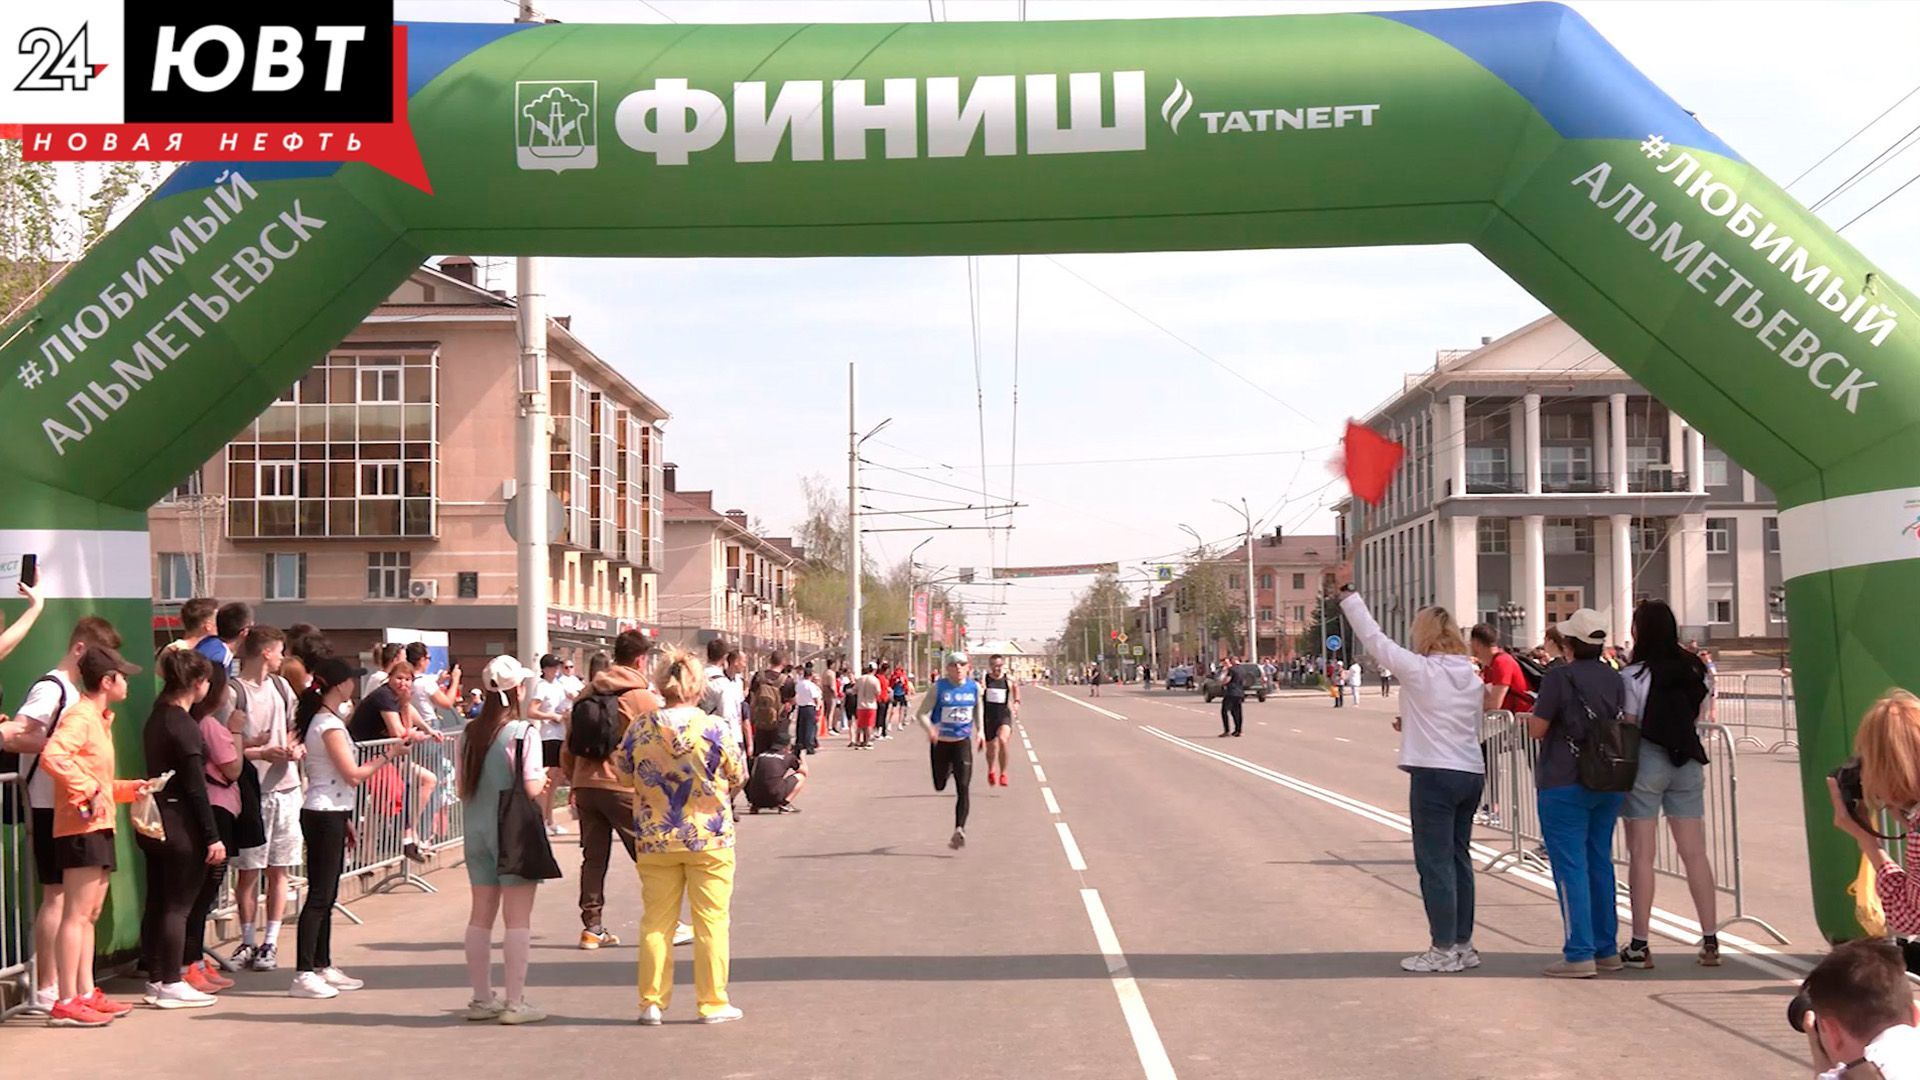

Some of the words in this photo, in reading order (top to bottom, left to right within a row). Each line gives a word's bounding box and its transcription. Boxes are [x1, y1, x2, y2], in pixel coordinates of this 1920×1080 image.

[614, 70, 1146, 166] ФИНИШ
[1199, 103, 1381, 134] TATNEFT
[17, 169, 259, 390] #ЛЮБИМЫЙ
[41, 198, 328, 456] АЛЬМЕТЬЕВСК
[1571, 162, 1879, 414] АЛЬМЕТЬЕВСК
[1640, 134, 1898, 348] #ЛЮБИМЫЙ
